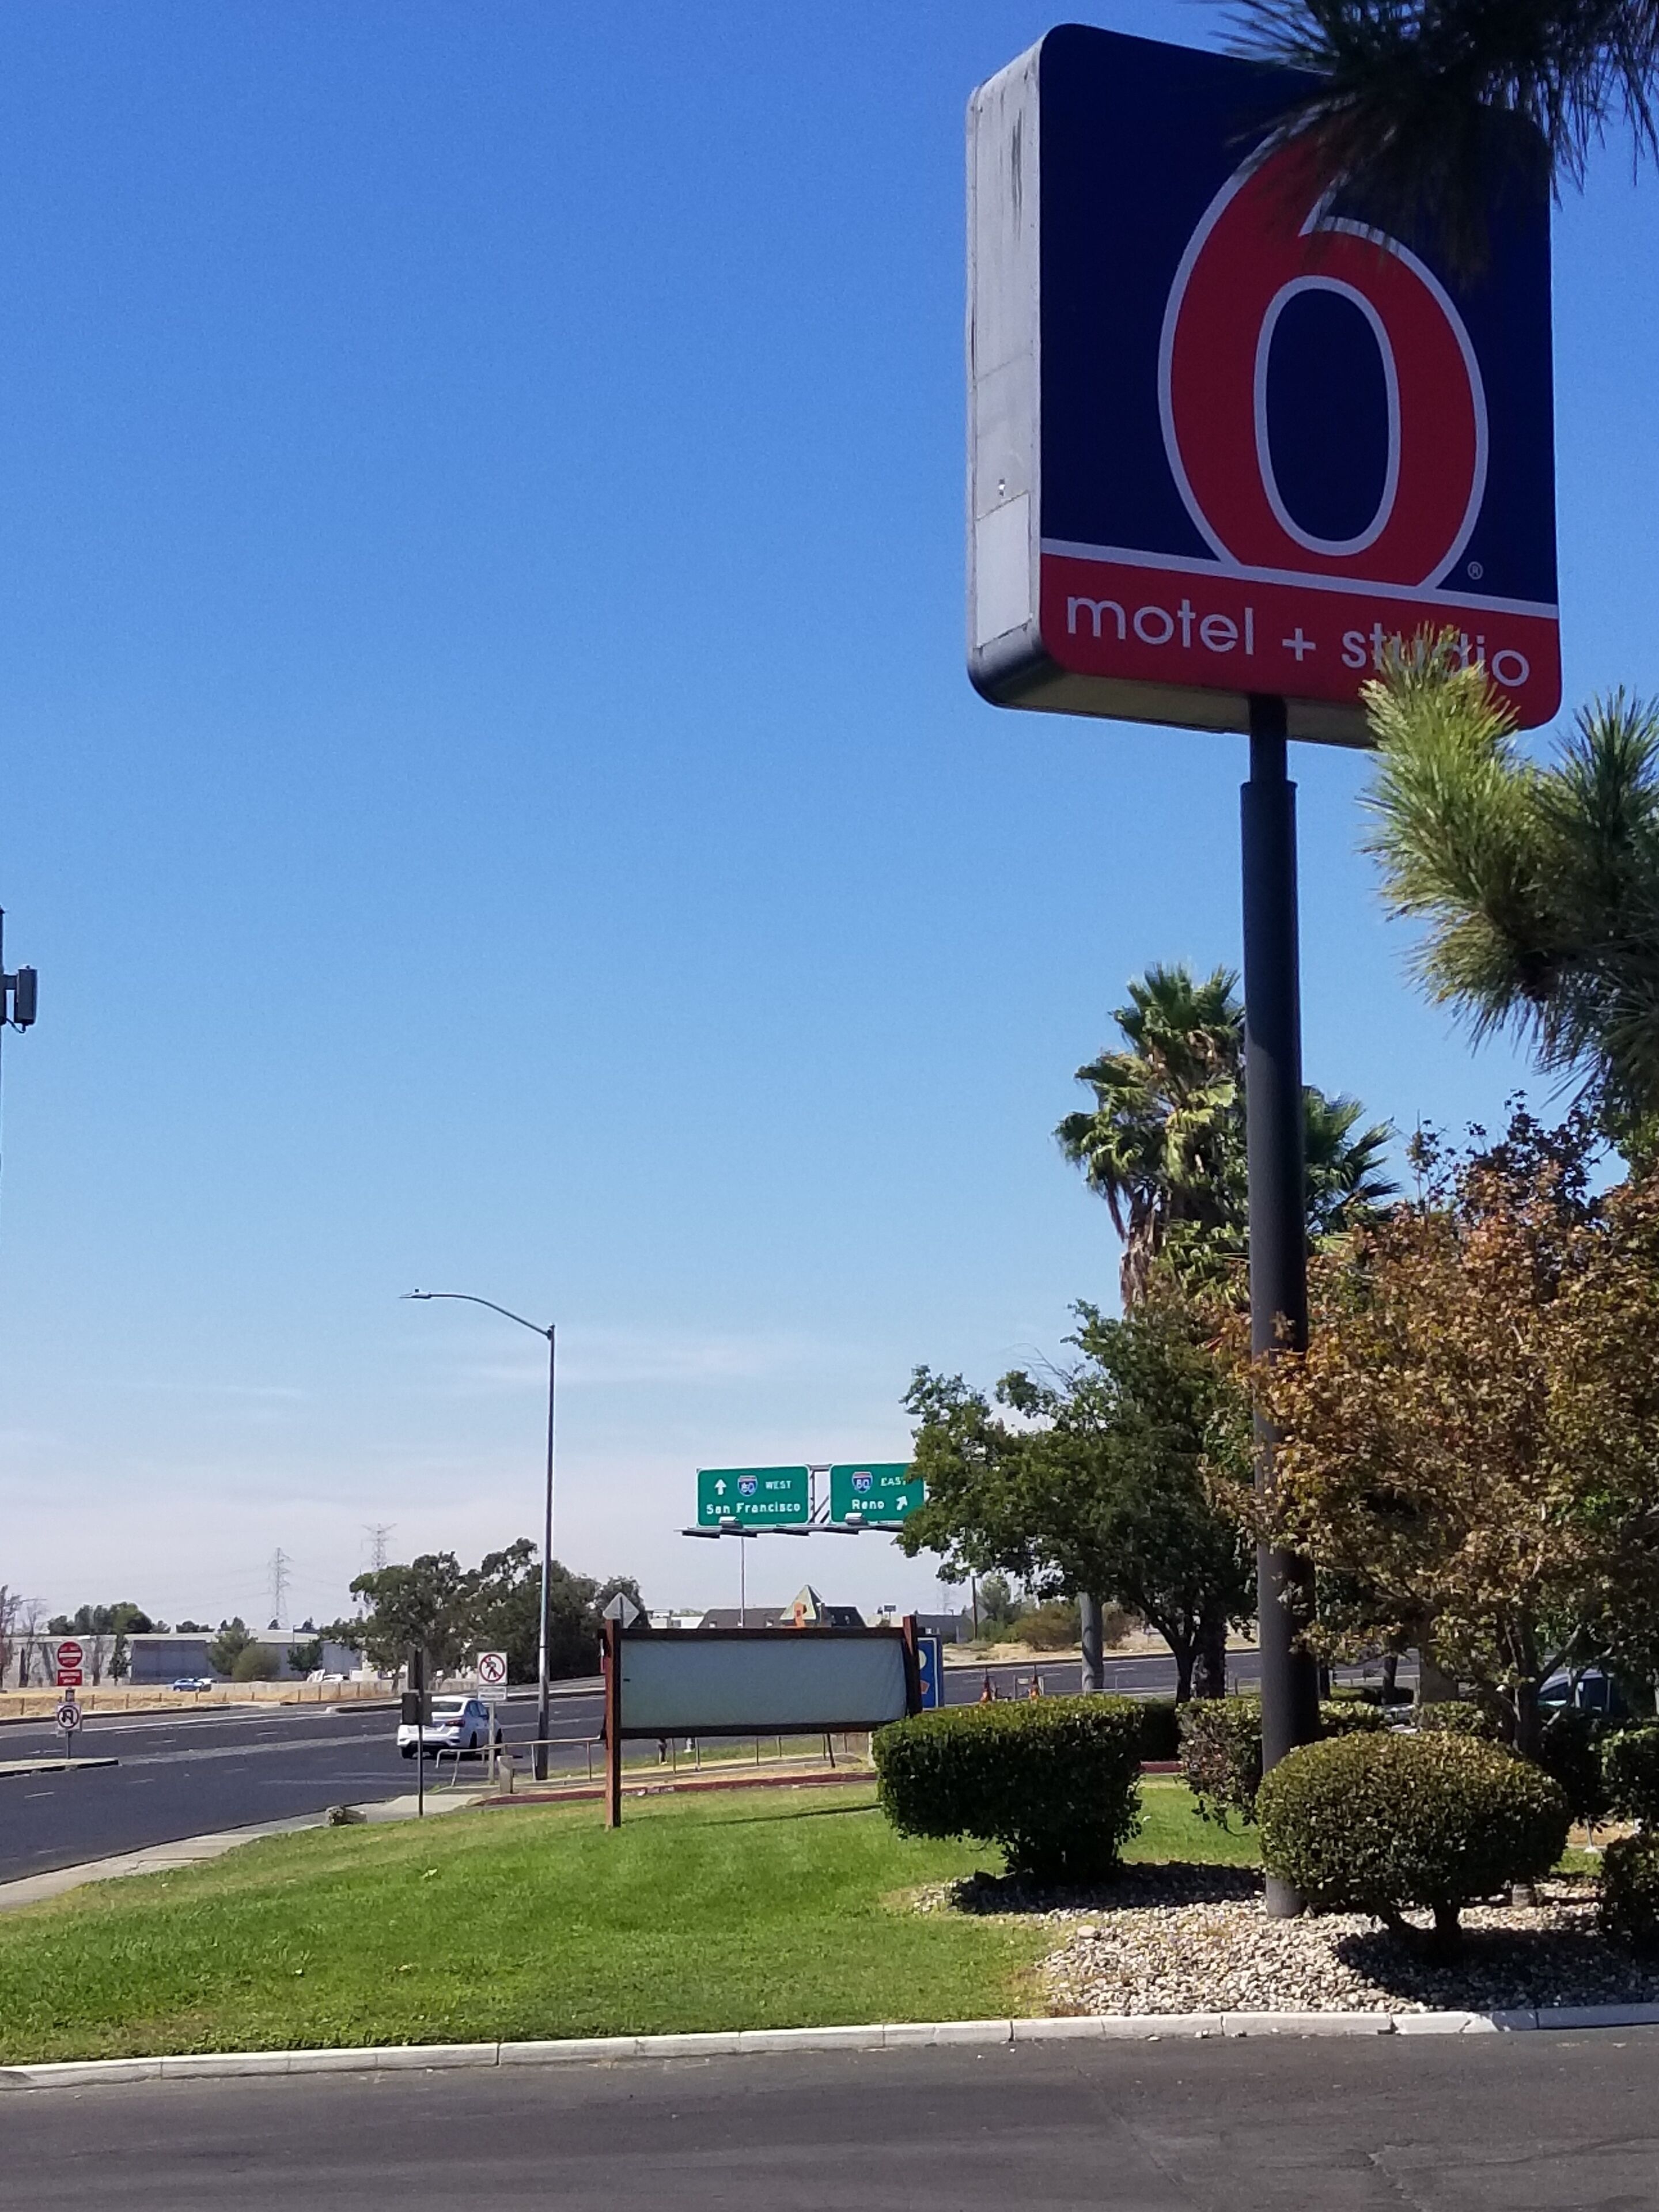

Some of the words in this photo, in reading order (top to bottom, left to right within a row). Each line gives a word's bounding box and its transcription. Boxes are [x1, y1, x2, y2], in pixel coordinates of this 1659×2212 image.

[1157, 92, 1489, 589] 6
[1067, 596, 1253, 656] motel
[766, 1480, 791, 1490] WEST
[857, 1479, 870, 1489] 80
[706, 1503, 730, 1514] San
[736, 1501, 801, 1513] Francisco
[851, 1499, 885, 1510] Reno
